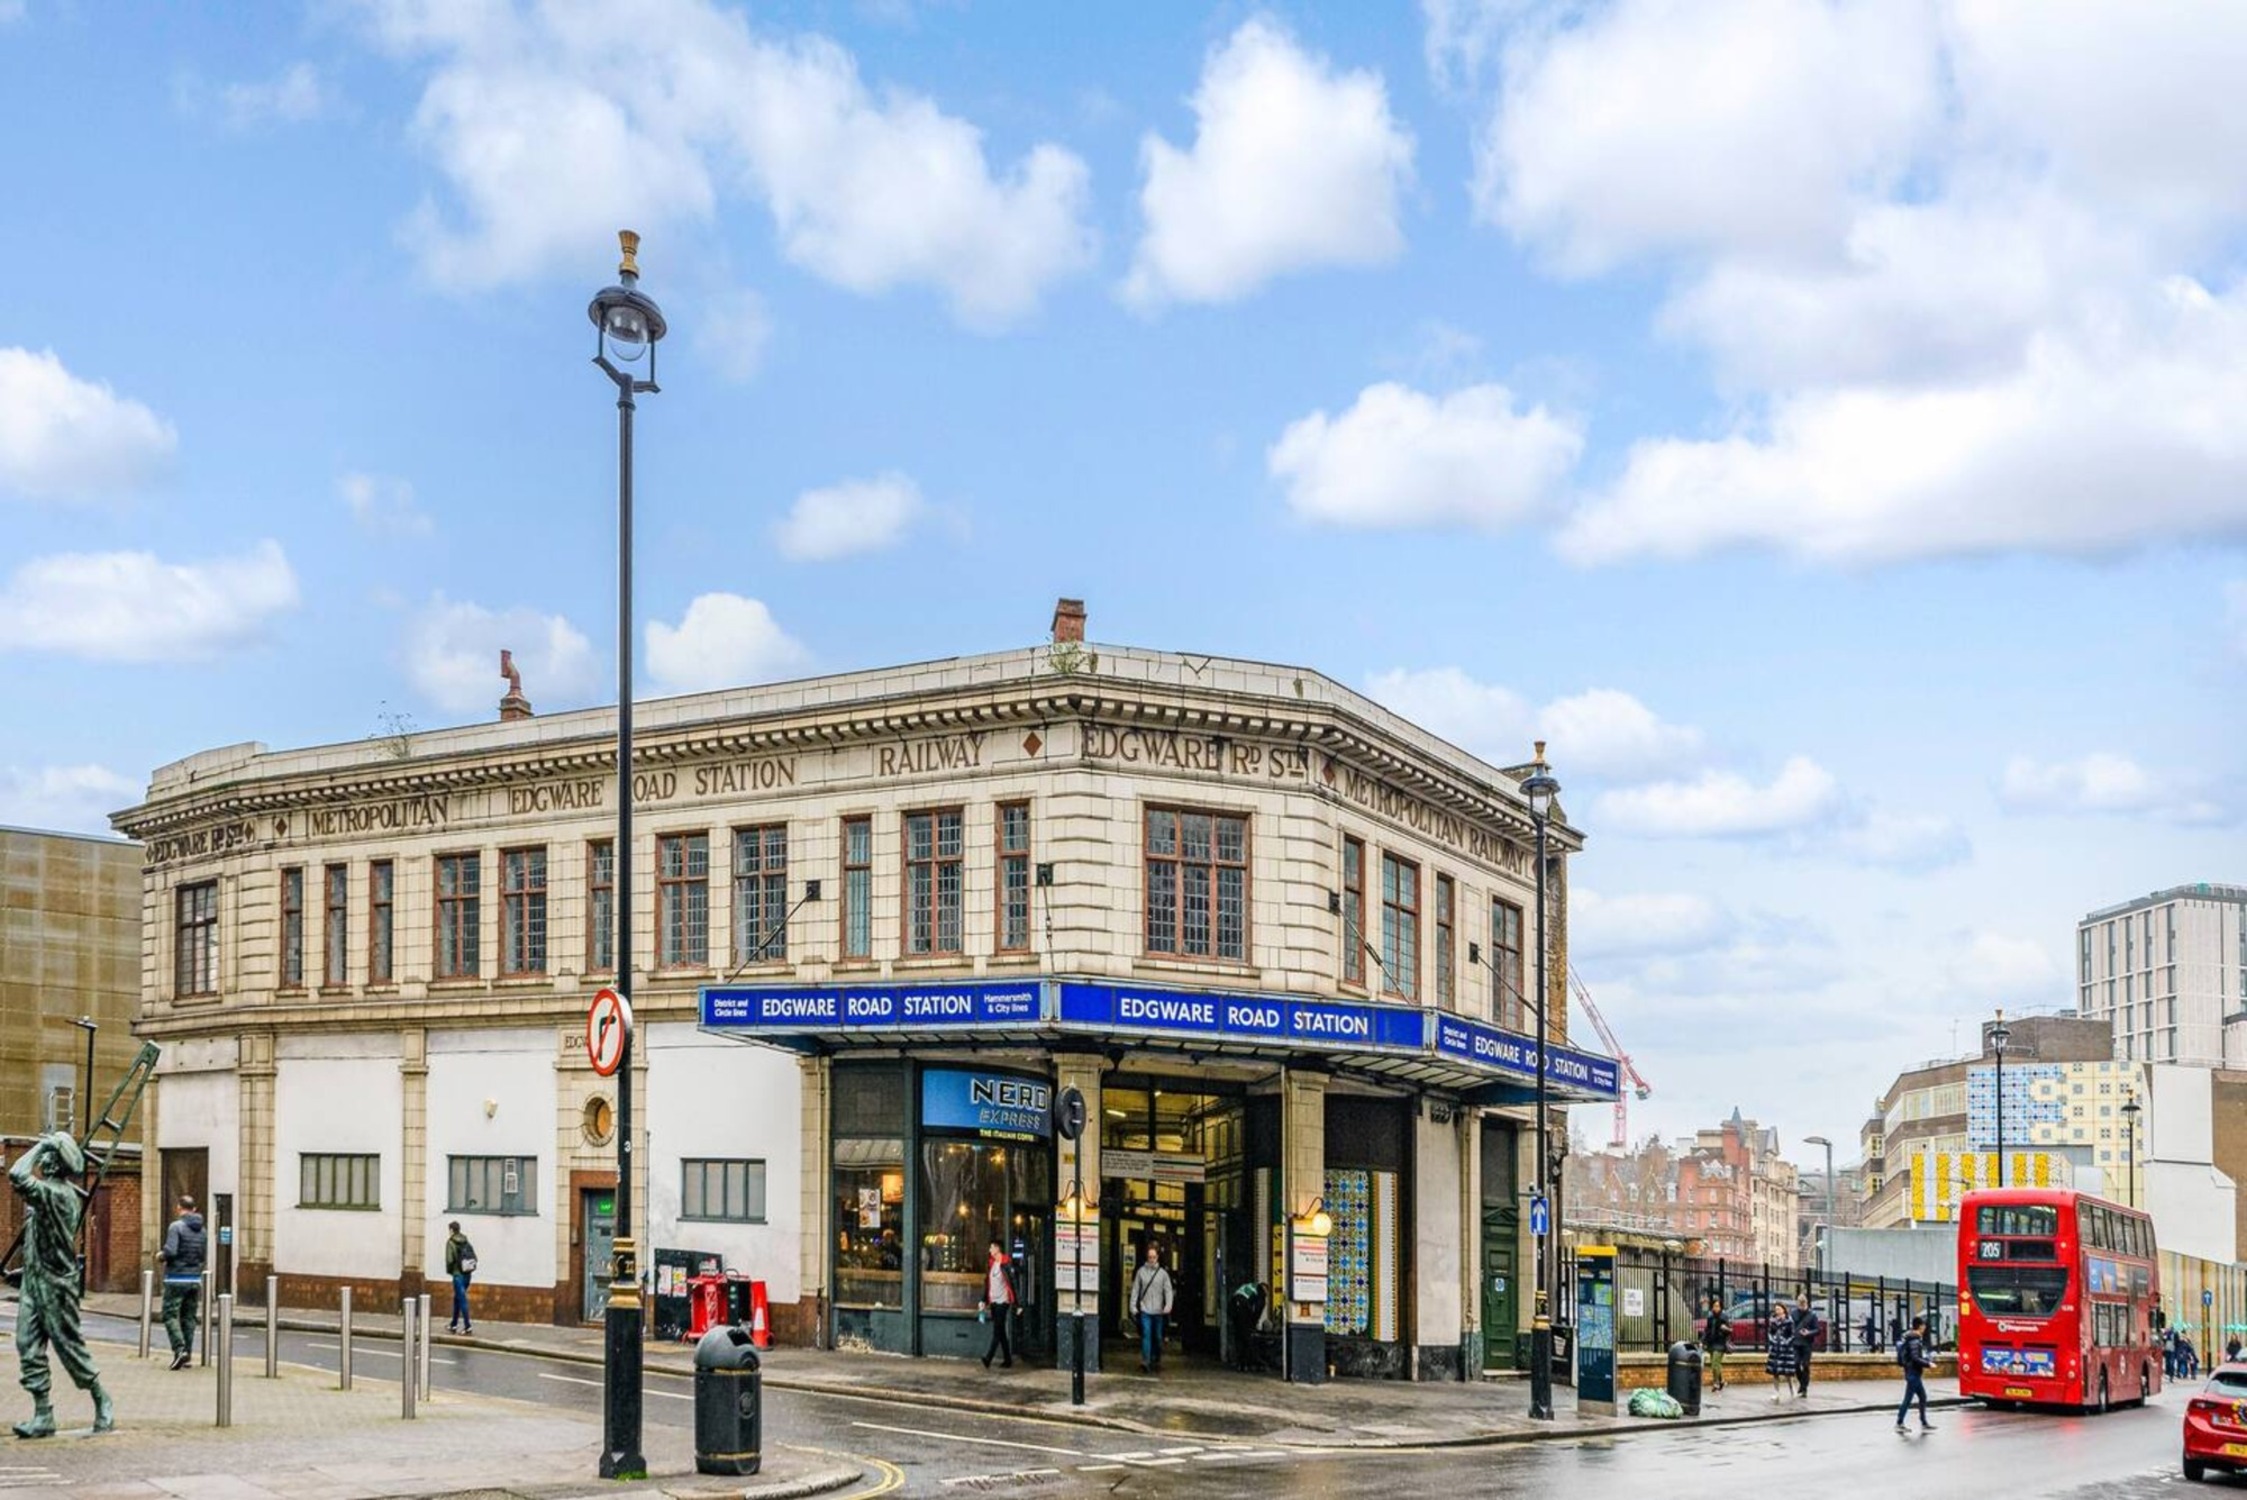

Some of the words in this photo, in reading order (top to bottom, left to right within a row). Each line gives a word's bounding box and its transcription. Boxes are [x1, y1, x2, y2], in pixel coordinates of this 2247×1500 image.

[879, 732, 986, 777] RAILWAY
[1081, 723, 1221, 771] EDGWARE
[511, 779, 605, 815] EDGWARE
[632, 771, 677, 803] OAD
[695, 757, 796, 796] STATION
[312, 796, 449, 837] METROPOLITAN
[1344, 770, 1464, 848] METROPOLITAN
[1468, 827, 1526, 875] RAILWAY
[762, 998, 836, 1017] EDGWARE
[848, 997, 893, 1016] ROAD
[904, 995, 972, 1015] STATION
[1120, 997, 1215, 1024] EDGWARE
[1228, 1006, 1280, 1028] ROAD
[1293, 1011, 1369, 1036] STATION
[1475, 1035, 1521, 1064] EDGWARE
[1525, 1049, 1550, 1071] ROD
[1555, 1057, 1589, 1081] STATION
[980, 1107, 1041, 1130] EXPRESS
[1982, 1241, 2001, 1258] 205
